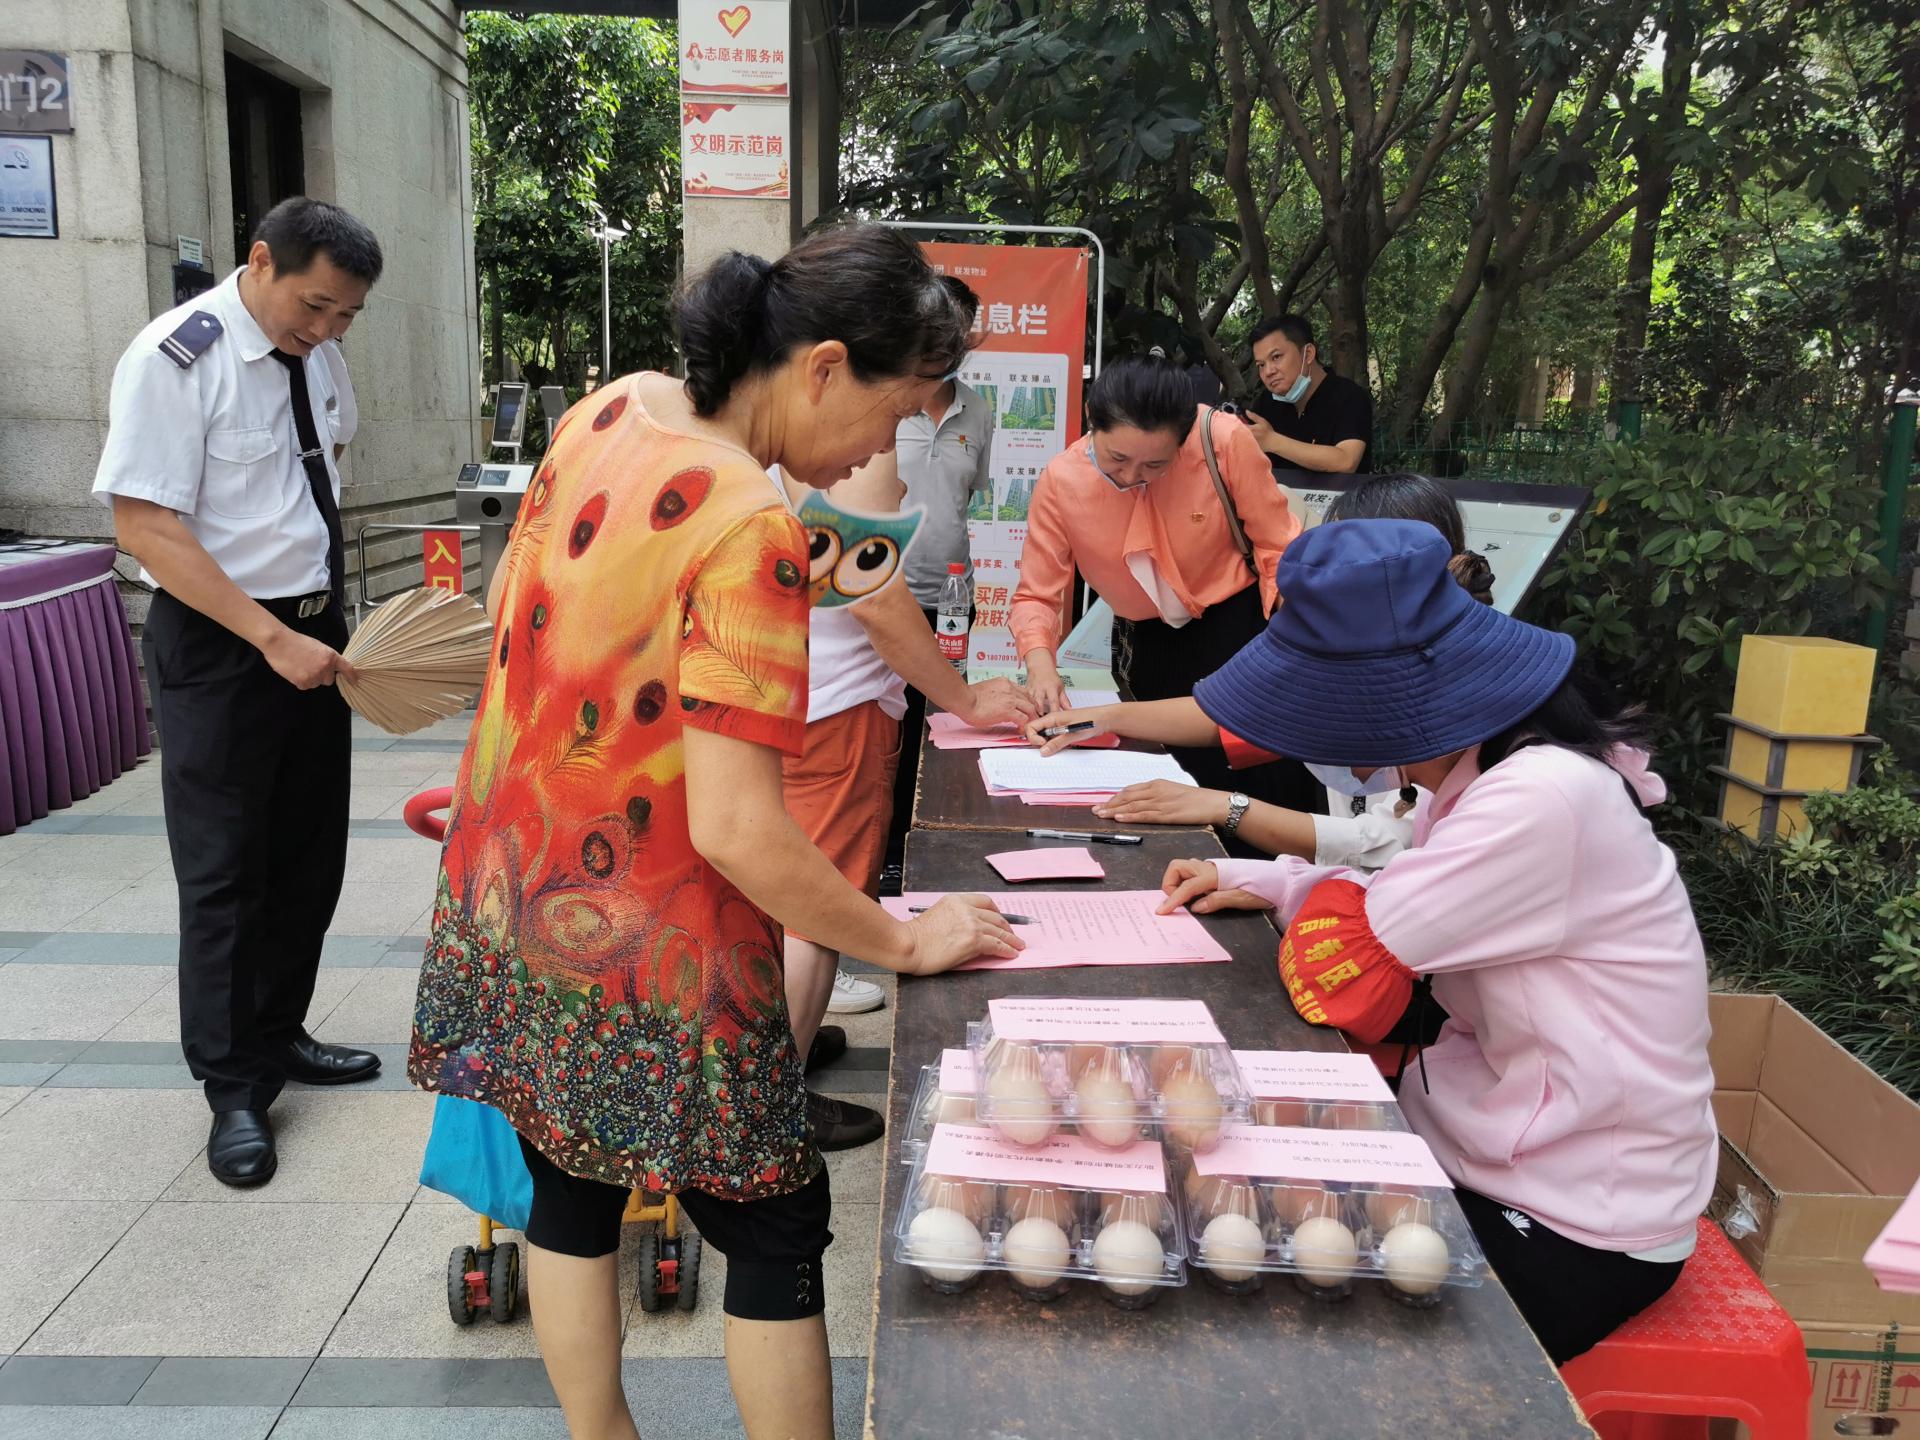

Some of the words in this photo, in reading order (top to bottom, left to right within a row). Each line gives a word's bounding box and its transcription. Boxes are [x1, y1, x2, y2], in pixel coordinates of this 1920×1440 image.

[703, 47, 784, 64] 志愿者服务岗
[690, 133, 783, 156] 文明示范岗
